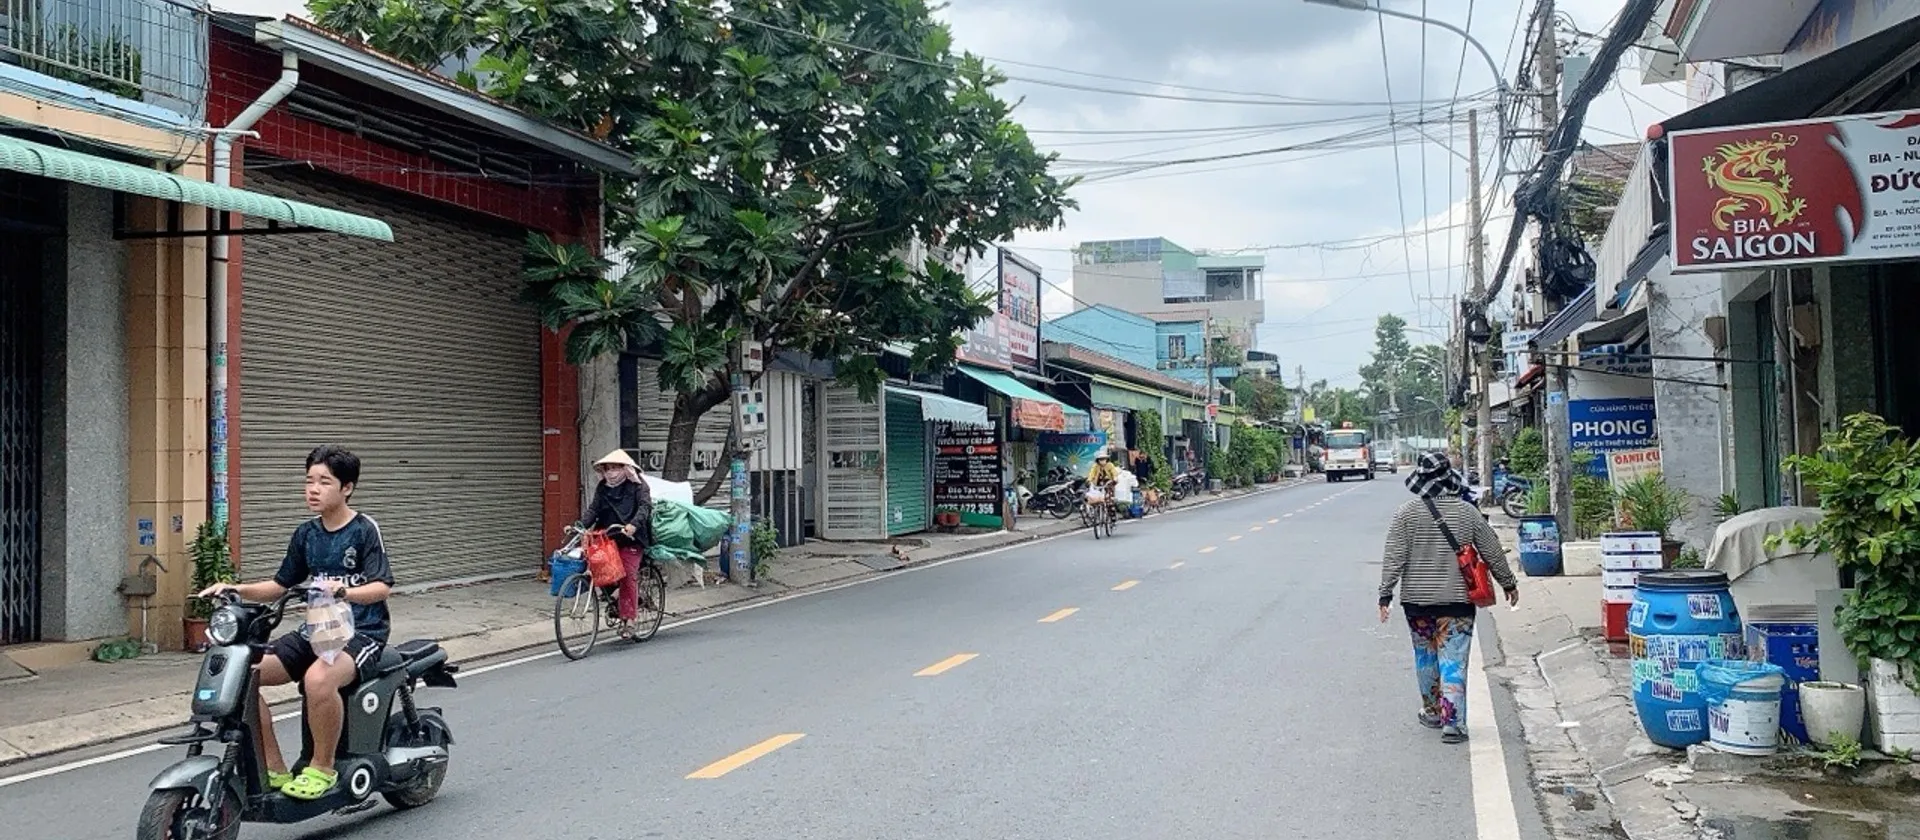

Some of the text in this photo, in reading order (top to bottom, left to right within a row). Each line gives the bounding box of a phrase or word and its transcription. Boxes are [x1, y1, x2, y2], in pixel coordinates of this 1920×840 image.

[1869, 153, 1892, 164] BIA
[1874, 209, 1888, 218] BIA
[1733, 217, 1772, 234] BIA
[1692, 231, 1815, 260] SAIGON
[1606, 404, 1628, 412] HÀNG
[1572, 419, 1647, 438] PHONG
